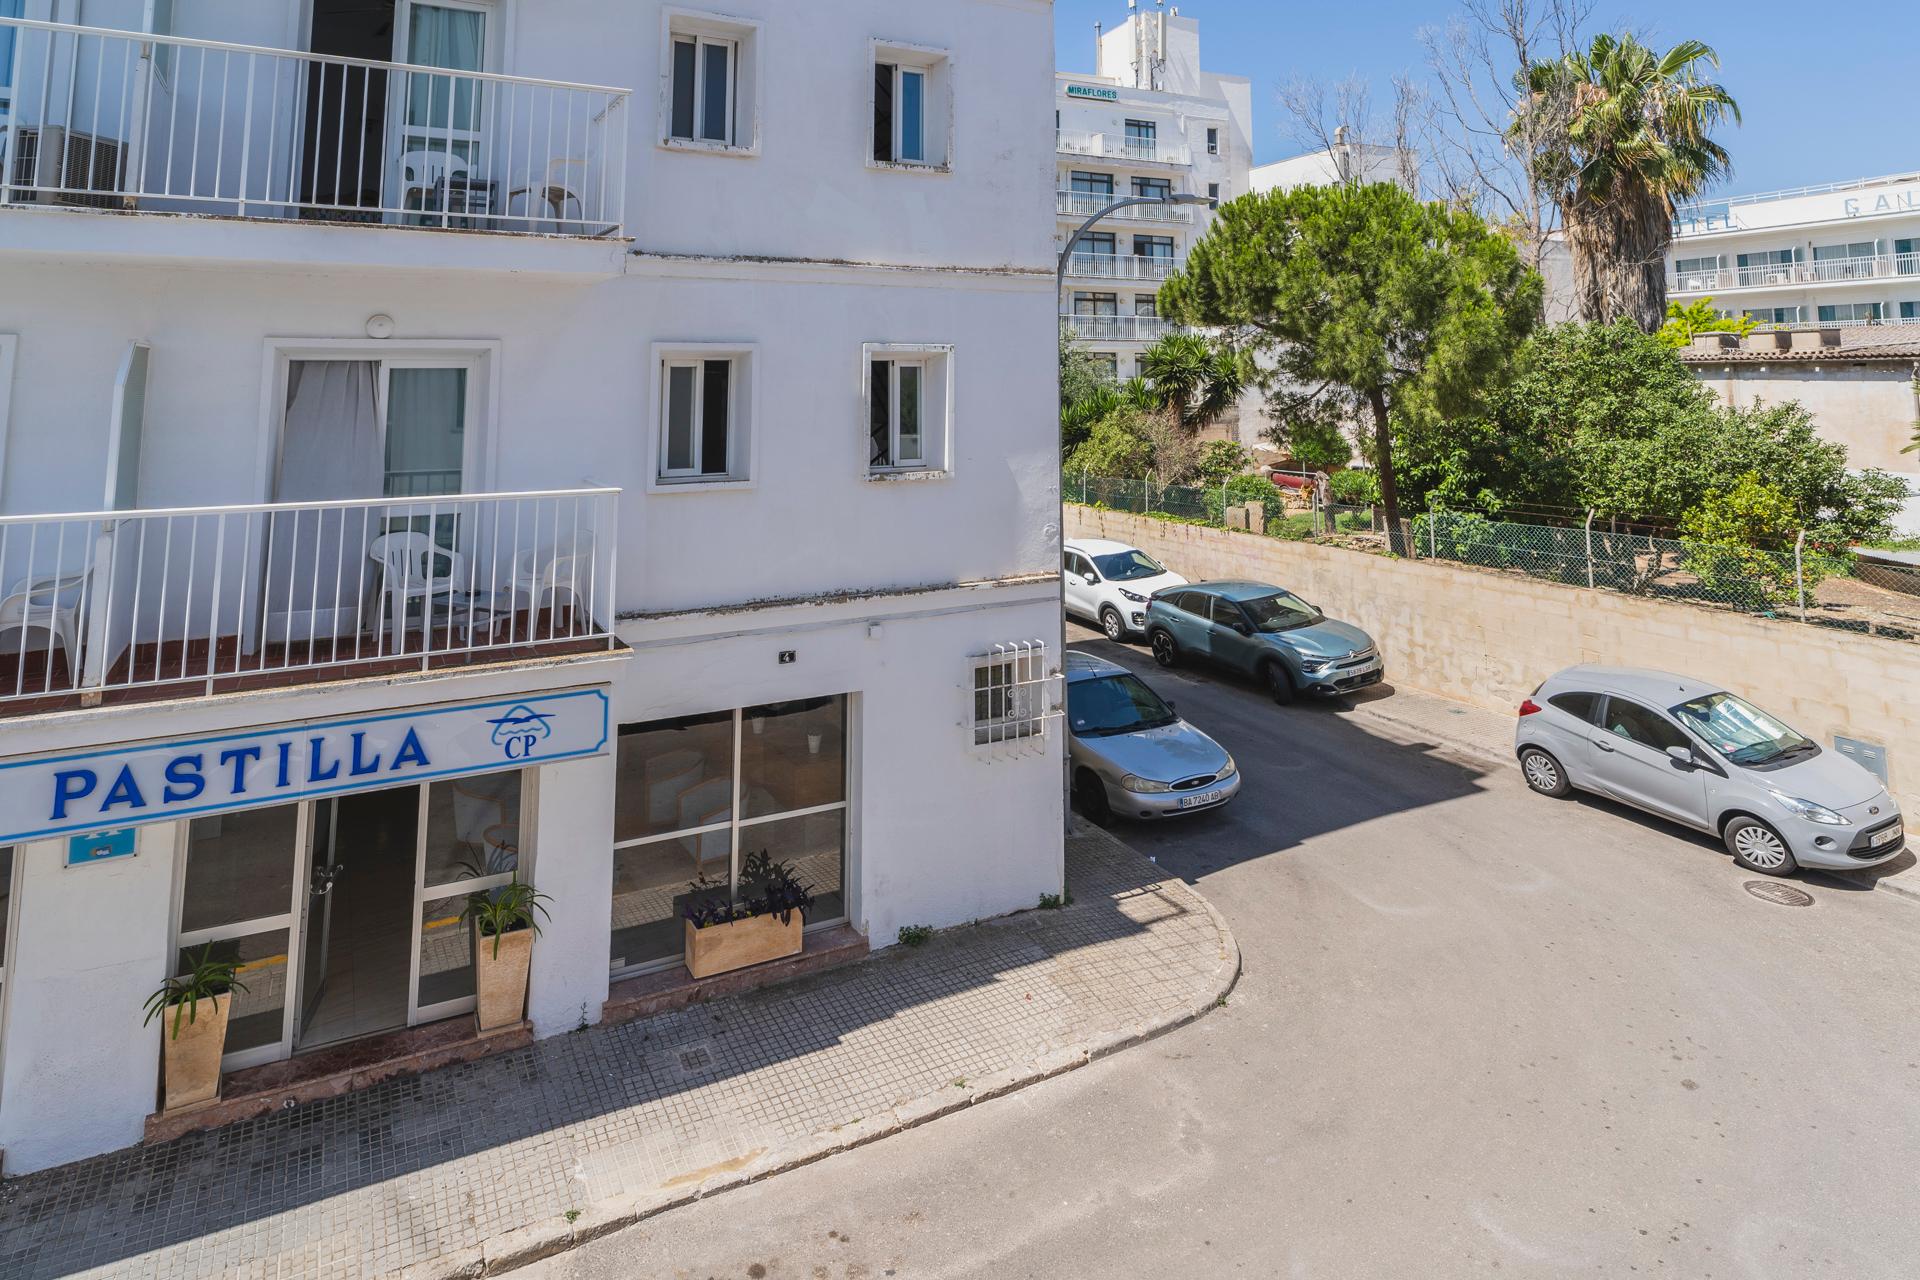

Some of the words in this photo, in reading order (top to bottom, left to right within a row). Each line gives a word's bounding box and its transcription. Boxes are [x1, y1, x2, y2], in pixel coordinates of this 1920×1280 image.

[1068, 86, 1117, 99] MIRAFLORES
[504, 734, 537, 759] CP
[48, 726, 431, 821] PASTILLA
[1184, 798, 1192, 807] BA
[1193, 794, 1210, 805] 7240
